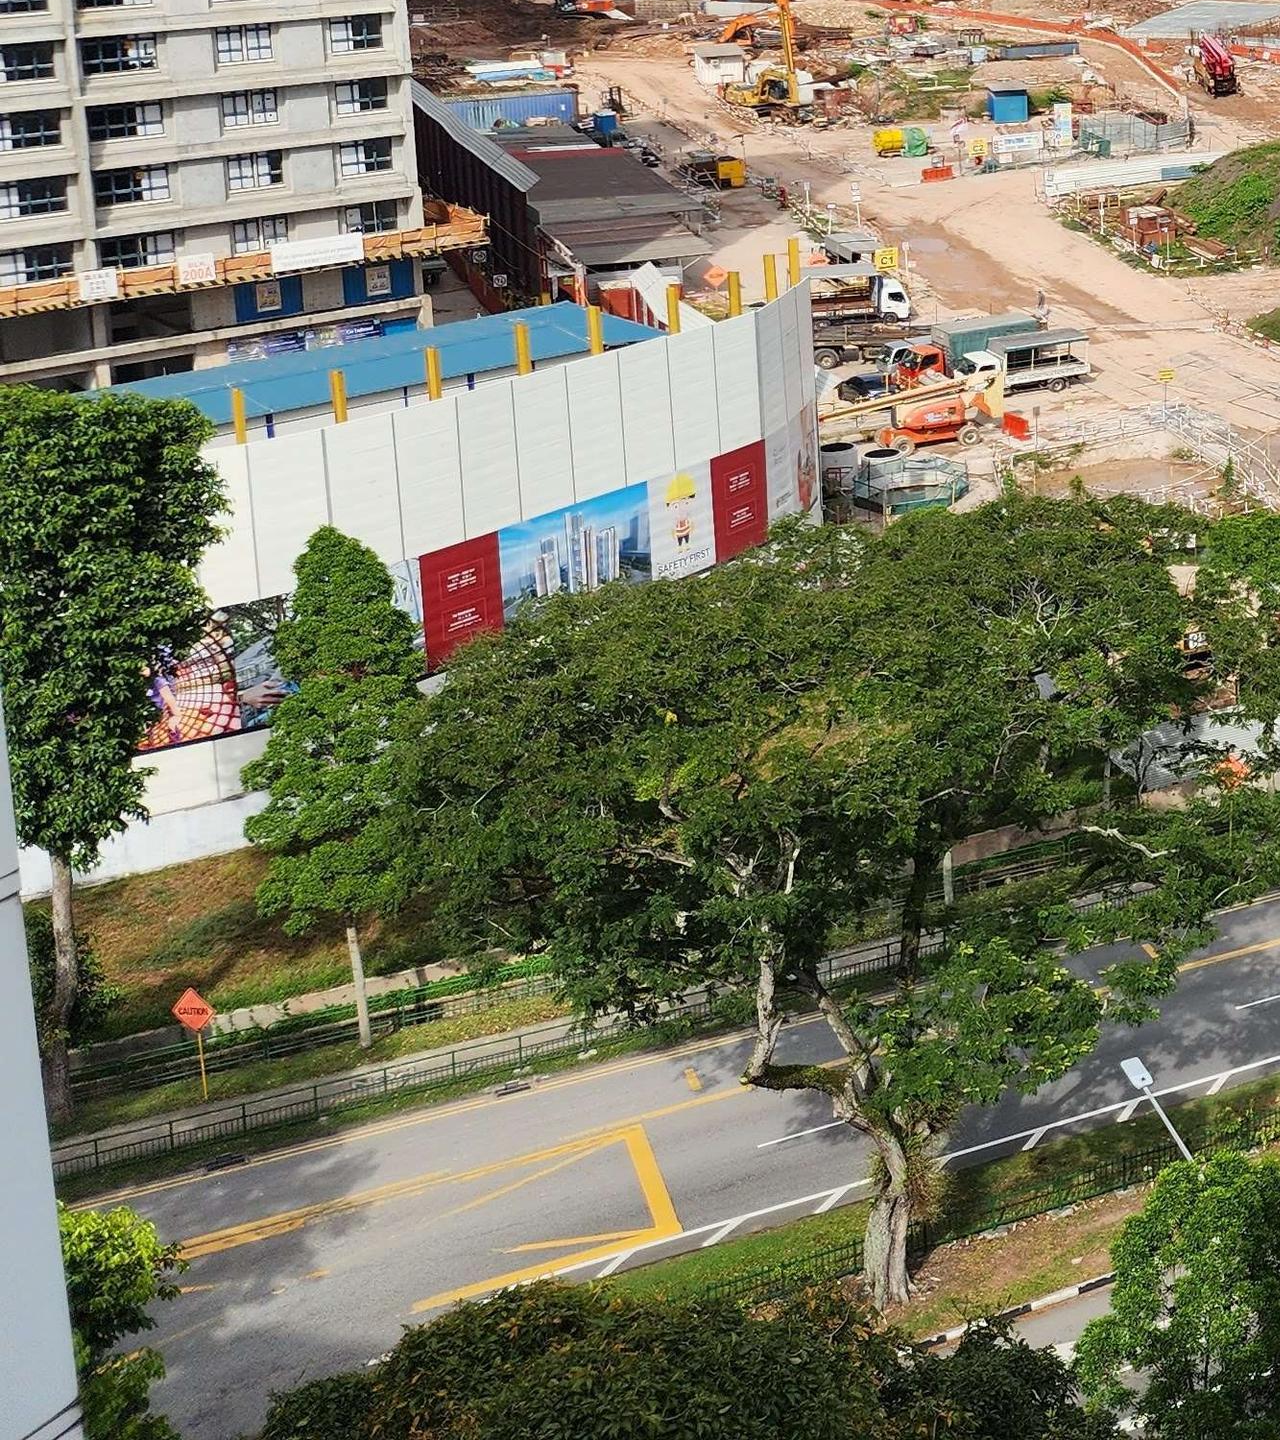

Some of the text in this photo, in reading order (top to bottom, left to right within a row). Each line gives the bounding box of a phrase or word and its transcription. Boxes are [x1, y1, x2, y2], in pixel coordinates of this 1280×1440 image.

[880, 256, 894, 265] C1
[183, 266, 214, 281] 200A
[657, 557, 689, 575] SAFETY
[689, 547, 710, 563] FIRST
[178, 1007, 209, 1016] CAUTION
